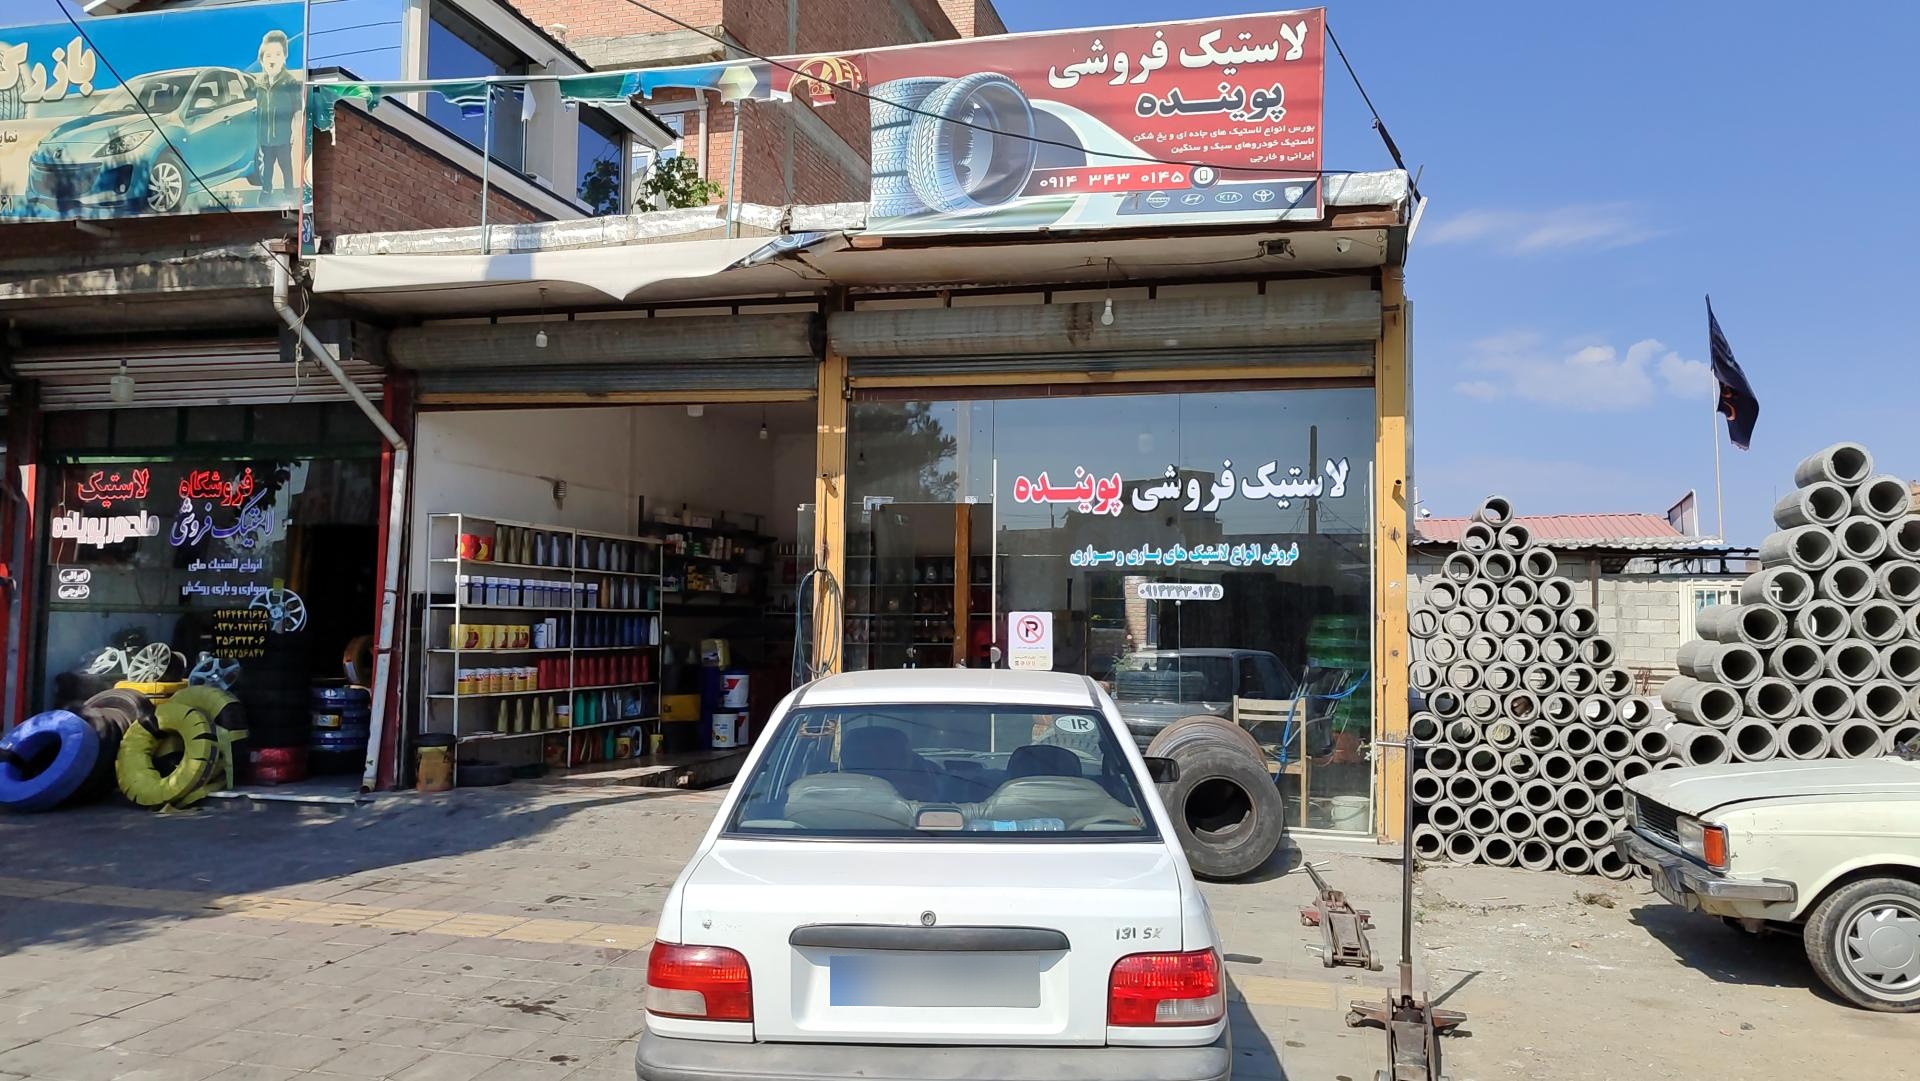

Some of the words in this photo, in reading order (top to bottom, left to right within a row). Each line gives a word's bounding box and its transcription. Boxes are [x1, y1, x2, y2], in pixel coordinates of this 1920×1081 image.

[1179, 21, 1308, 76] لاستیک
[1048, 30, 1169, 89] فروشی
[1135, 81, 1286, 122] پوینده
[1133, 132, 1155, 142] شکن
[1176, 131, 1187, 140] ای
[1188, 130, 1207, 140] جاده
[1210, 129, 1227, 139] های
[1229, 127, 1262, 138] لاستیک
[1264, 125, 1286, 137] انواع
[1288, 125, 1315, 134] بورس
[1171, 143, 1202, 154] سنگین
[1210, 141, 1233, 151] سبک
[1234, 139, 1279, 151] خودروهای
[1280, 137, 1315, 147] لاستیک
[1250, 153, 1278, 164] خارجی
[1287, 151, 1315, 162] ایرانی
[77, 467, 151, 508] لاستیک
[178, 467, 254, 507] فروشگاه
[1012, 465, 1124, 517] پوینده
[1131, 458, 1237, 514] فروشی
[1241, 456, 1351, 511] لاستیک
[169, 497, 213, 546] فروشی
[211, 487, 275, 548] لاستیک
[1070, 544, 1115, 567] سواری
[1115, 550, 1125, 567] و
[1126, 544, 1162, 567] باری
[1163, 543, 1188, 566] های
[1188, 543, 1229, 566] لاستیک
[1230, 543, 1261, 567] انواع
[1261, 542, 1300, 567] فروش
[187, 557, 207, 572] های
[208, 557, 239, 572] لاستیک
[239, 557, 263, 573] انواع
[182, 580, 210, 596] روکش
[213, 581, 231, 596] باری
[231, 585, 237, 595] و
[238, 581, 268, 596] سواری
[1070, 718, 1089, 730] IR
[1115, 926, 1137, 941] 131
